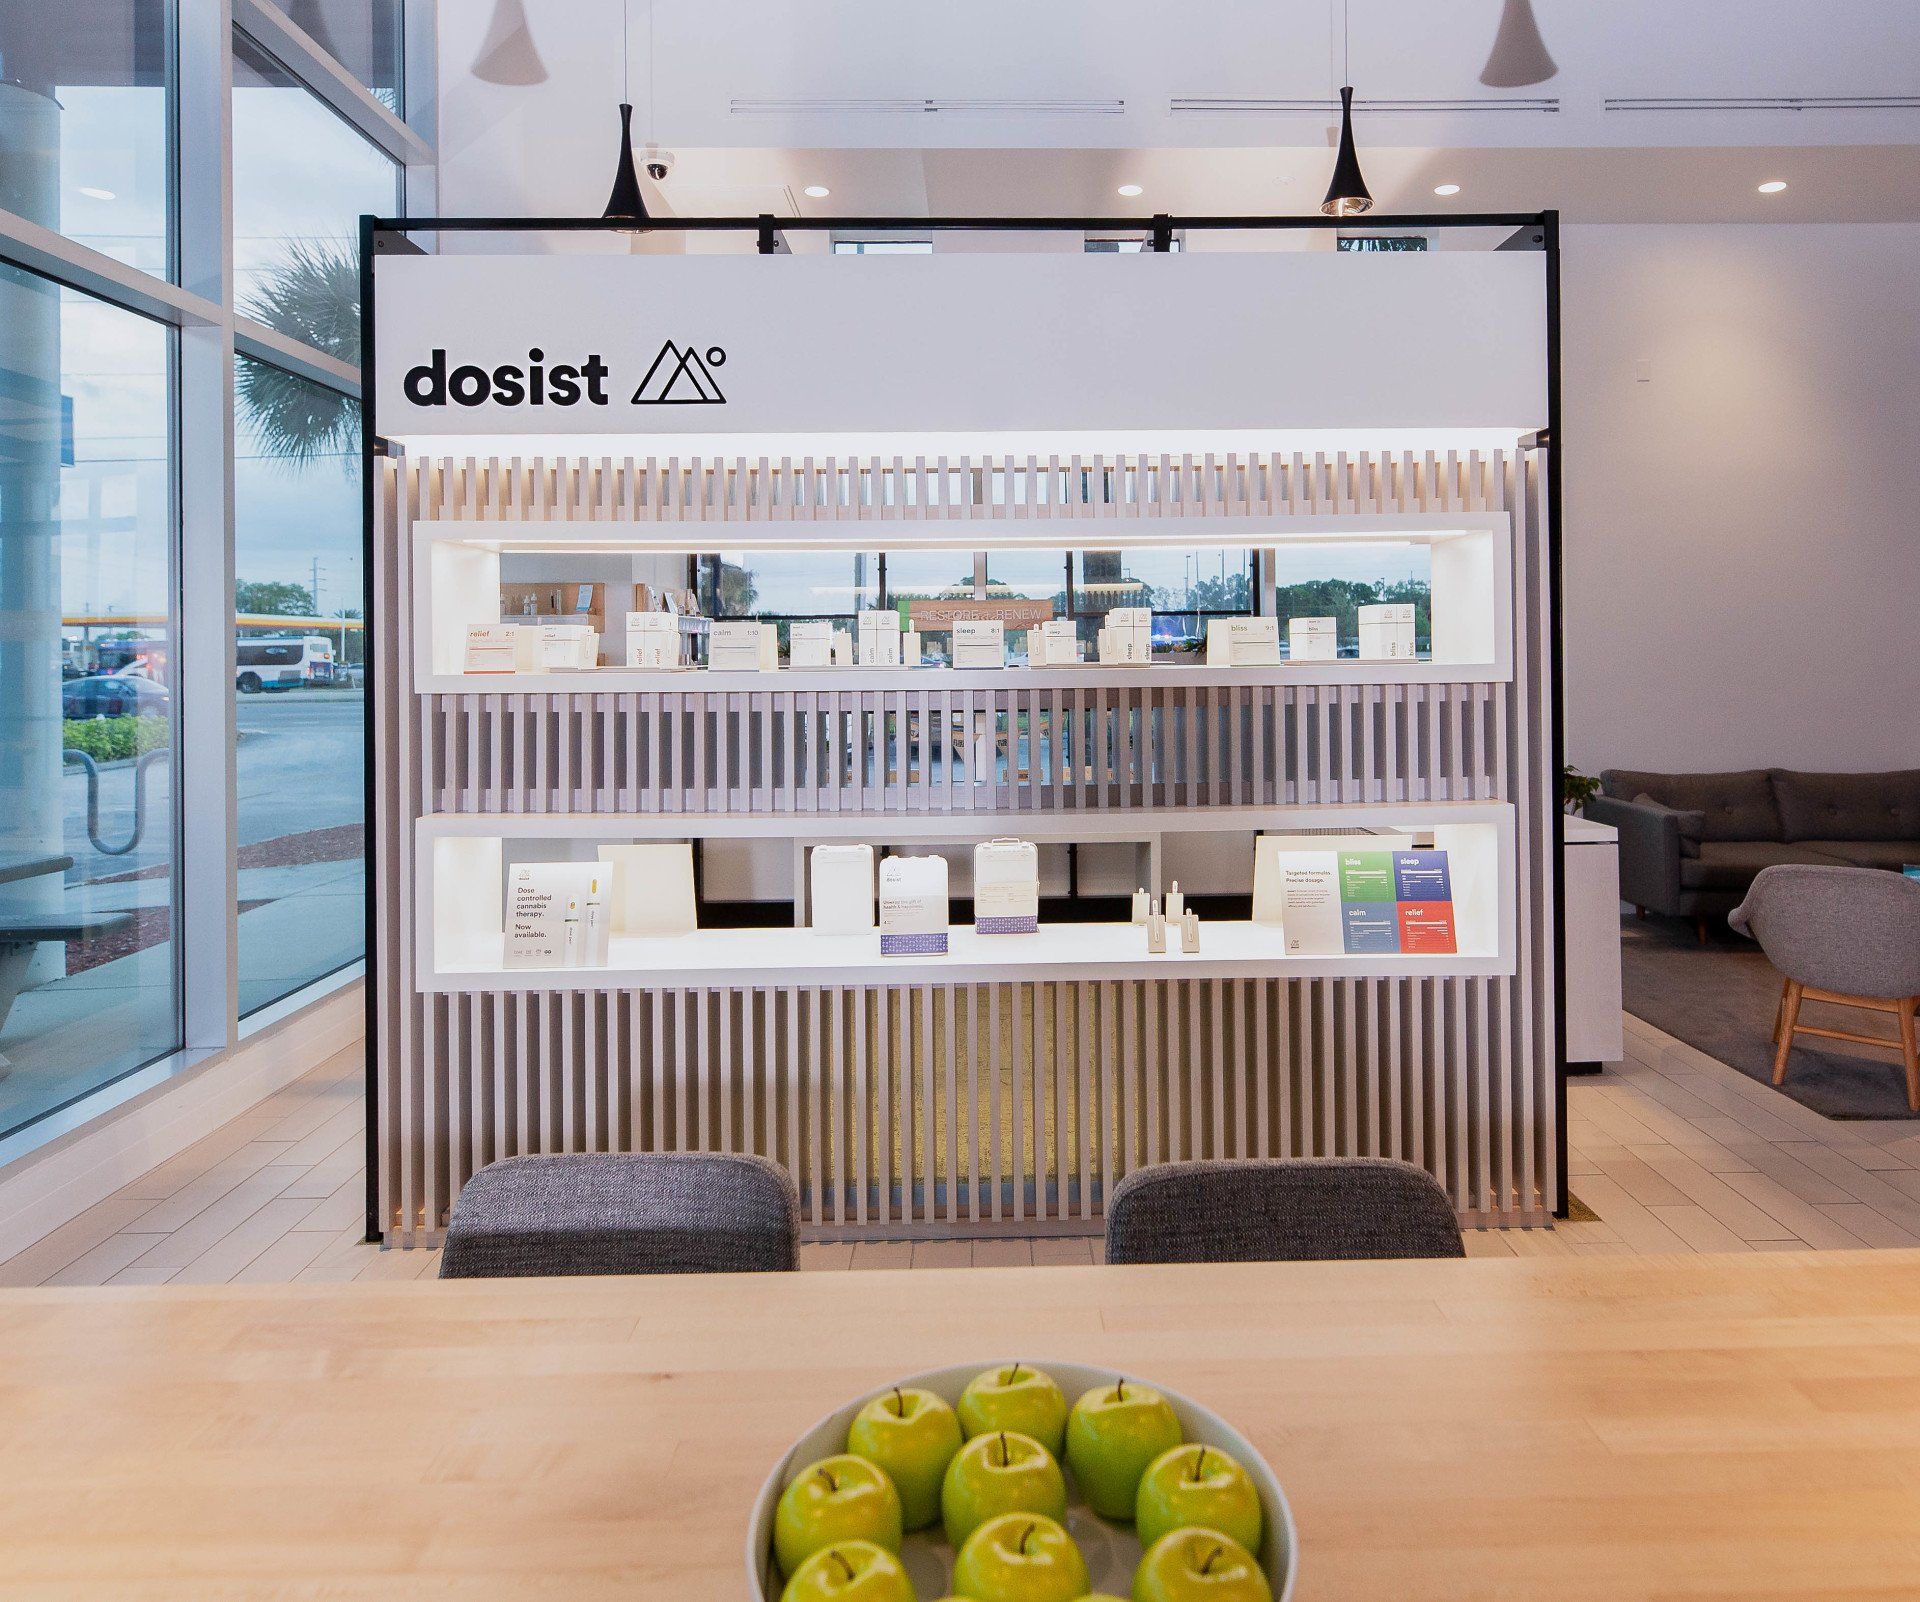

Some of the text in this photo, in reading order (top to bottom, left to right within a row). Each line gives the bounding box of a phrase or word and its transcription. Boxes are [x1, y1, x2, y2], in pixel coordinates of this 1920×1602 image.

[403, 347, 609, 407] dosist
[920, 609, 979, 621] RESTORE
[996, 609, 1043, 620] RENEW
[469, 630, 491, 638] relief
[956, 627, 976, 635] sleep
[1345, 858, 1362, 866] bliss
[1400, 858, 1420, 867] sleep
[1405, 908, 1424, 916] relief
[514, 931, 547, 939] available.
